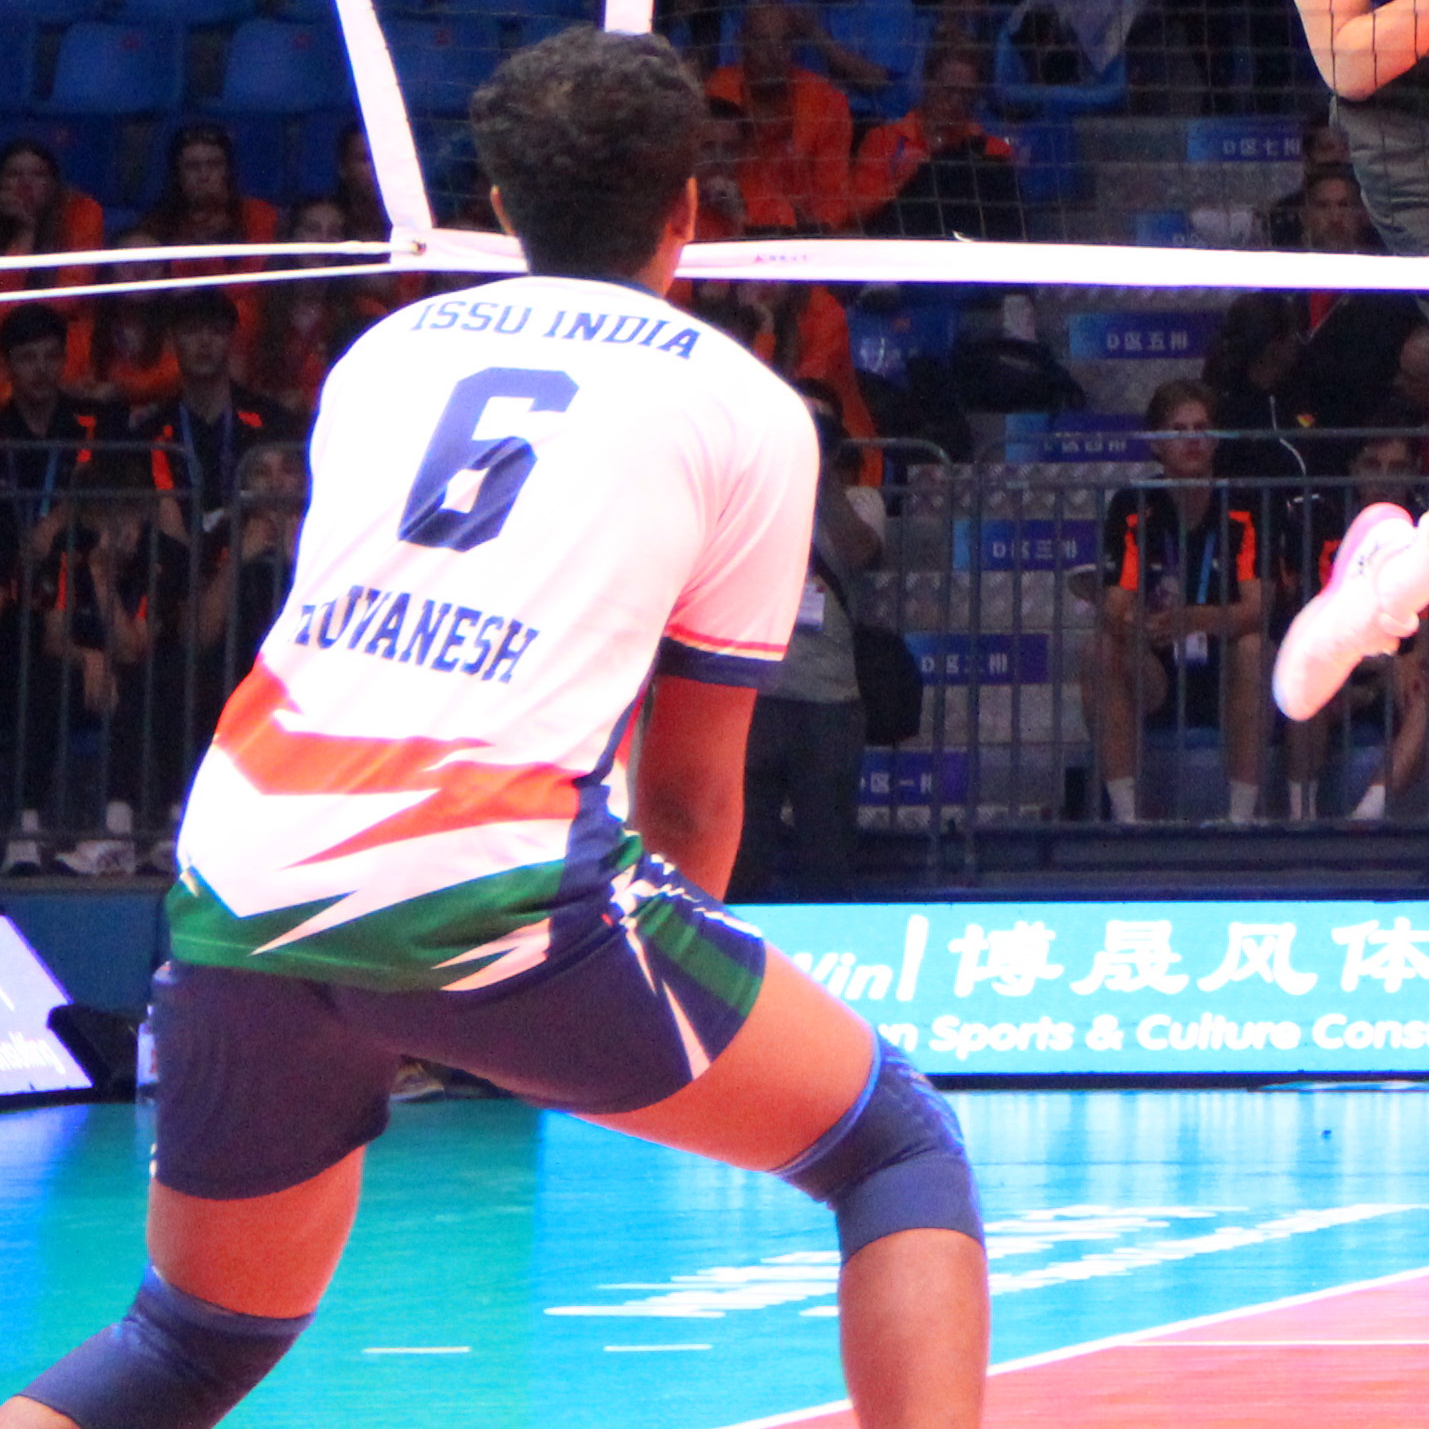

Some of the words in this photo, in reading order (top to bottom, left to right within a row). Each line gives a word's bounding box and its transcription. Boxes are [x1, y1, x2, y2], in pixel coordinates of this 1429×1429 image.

[541, 310, 702, 361] INDIA
[397, 367, 580, 553] 6
[929, 1014, 1075, 1061] Sports
[1085, 1013, 1125, 1051] &
[1136, 1012, 1302, 1050] Culture
